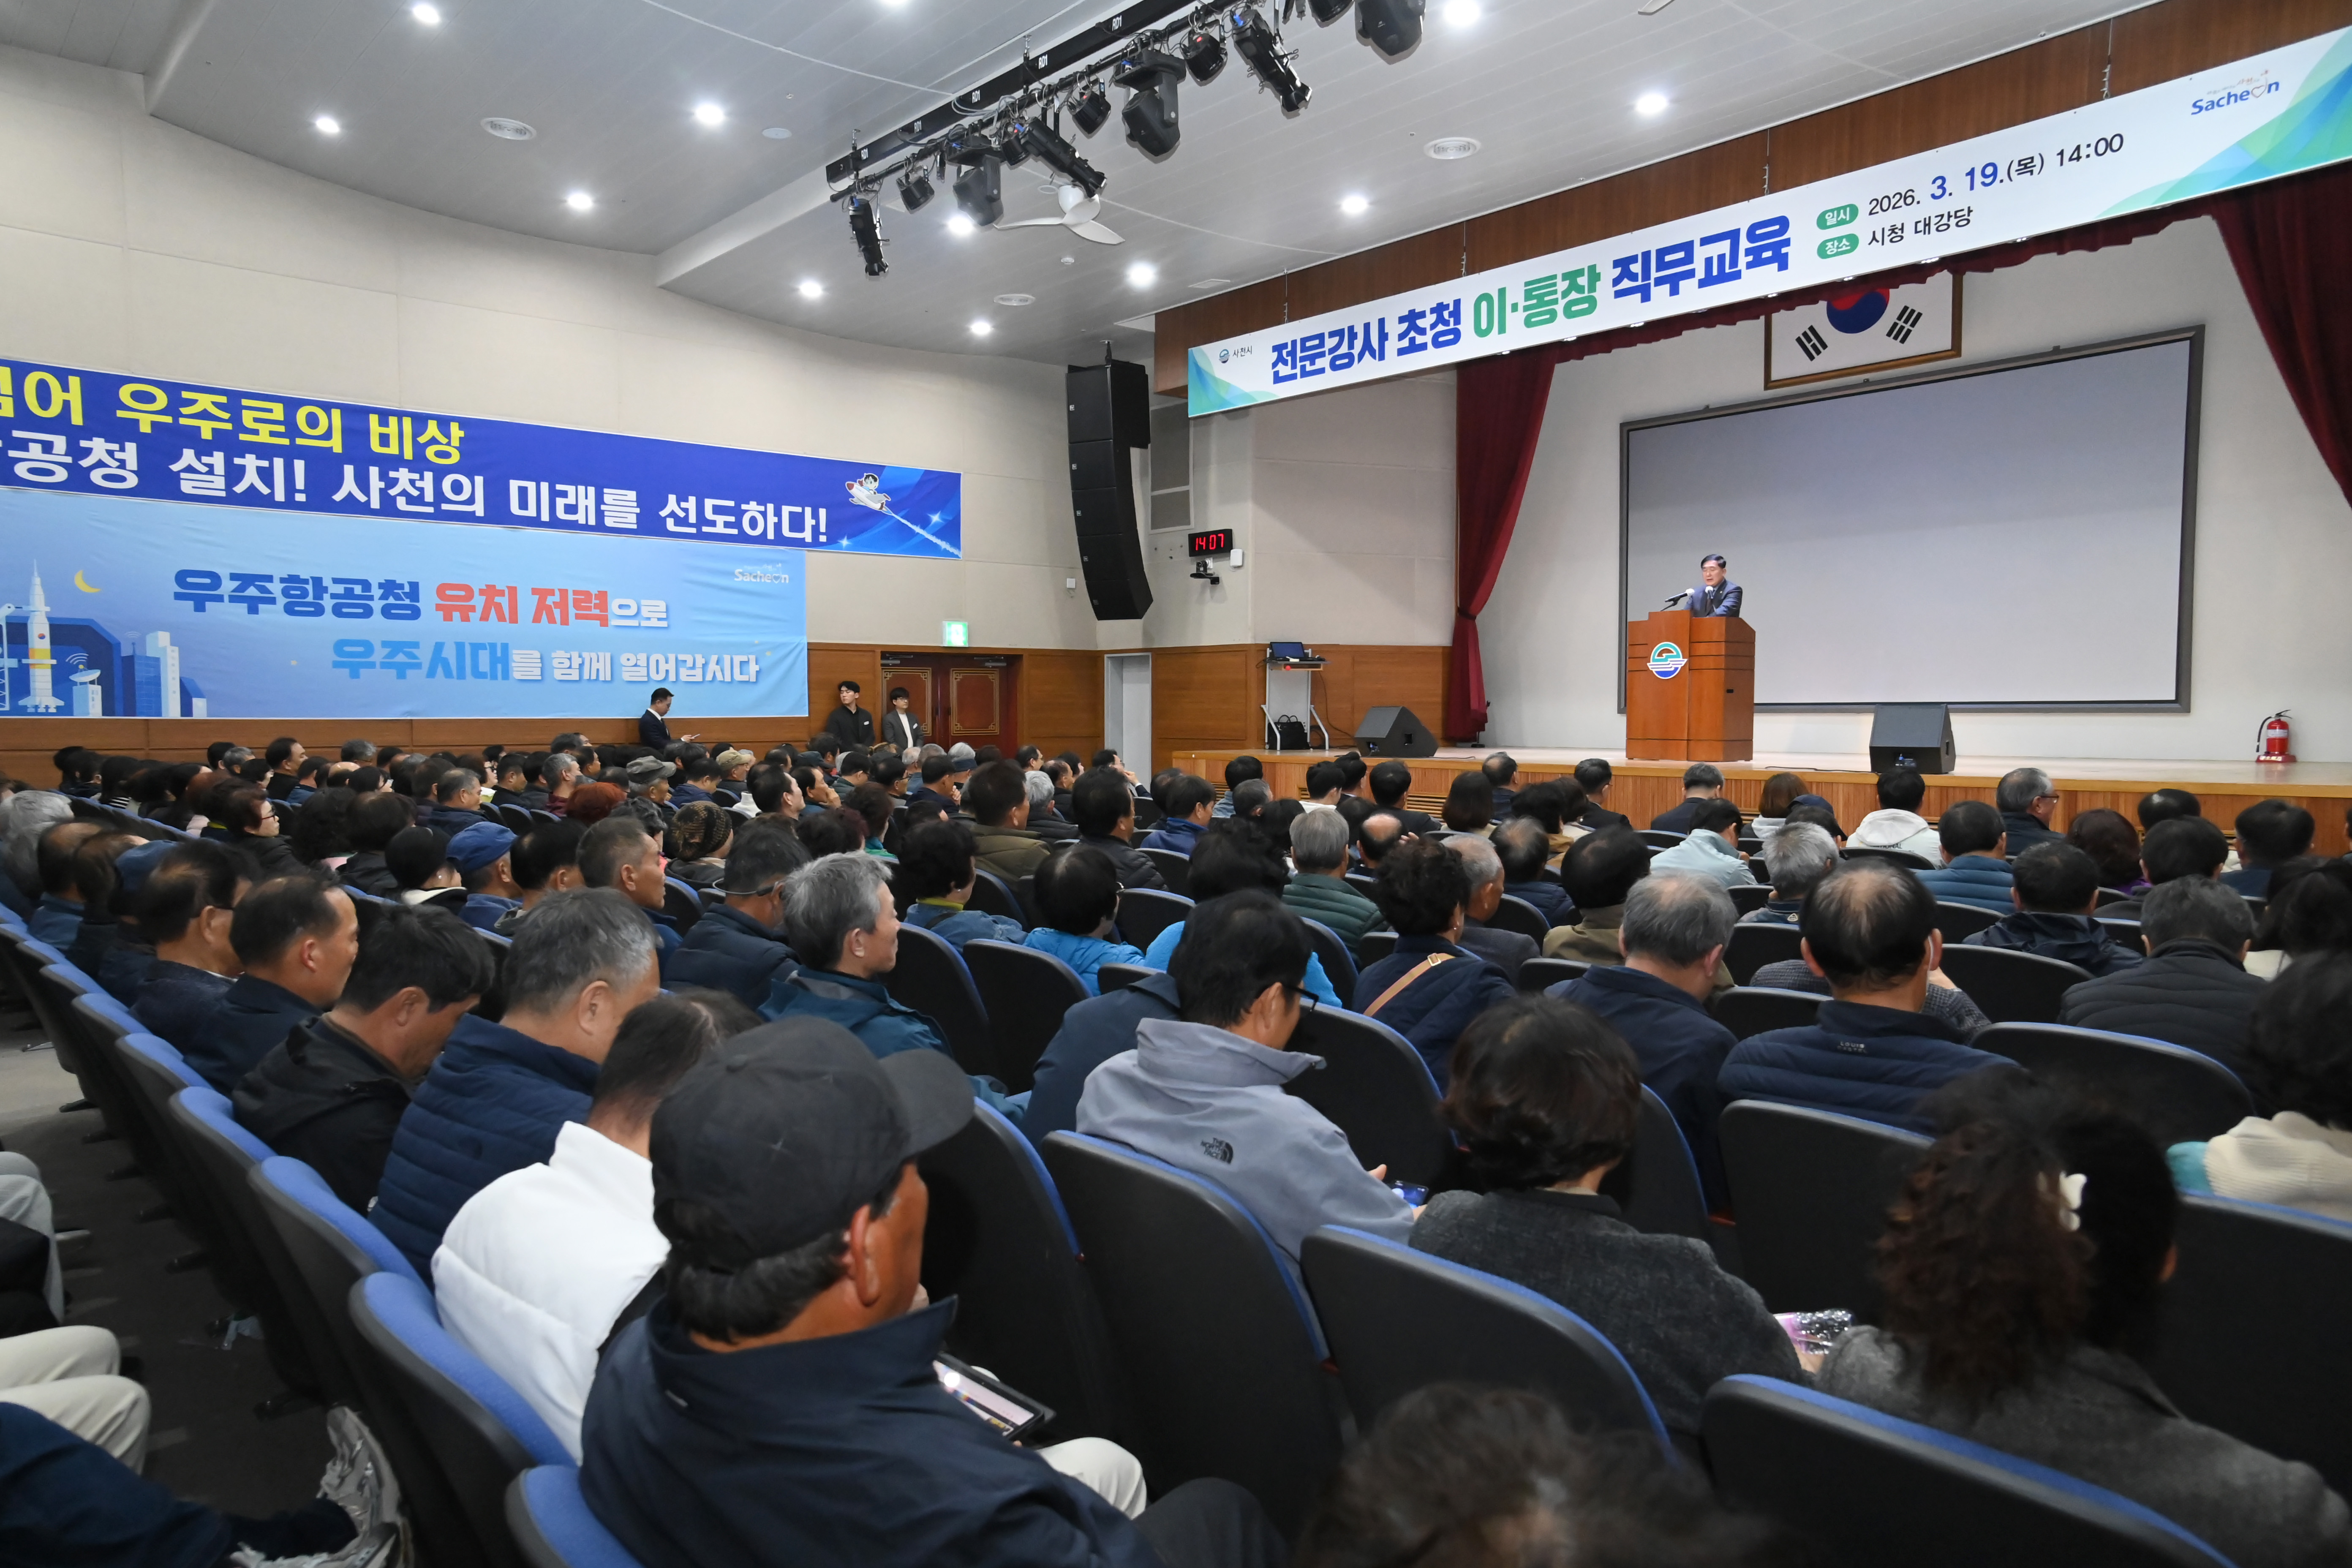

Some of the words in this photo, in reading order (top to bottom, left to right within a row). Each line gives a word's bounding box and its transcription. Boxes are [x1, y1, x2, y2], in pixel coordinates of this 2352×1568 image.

[1112, 15, 1122, 31] RD1
[1038, 54, 1048, 69] RD1
[972, 90, 980, 103] RD1
[914, 120, 922, 133] RD1
[1868, 189, 1921, 216] 2026.
[1930, 175, 1953, 200] 3.
[2056, 133, 2124, 167] 14:00
[1825, 207, 1850, 226] 일시
[1868, 223, 1905, 246] 시청
[1914, 206, 1973, 235] 대강당
[1825, 238, 1851, 255] 장소
[1271, 318, 1389, 385] 전문강사
[1396, 298, 1462, 357] 초청
[1612, 215, 1791, 304] 직무교육
[1232, 345, 1252, 358] 사천시
[0, 366, 84, 426] 어
[117, 383, 343, 453] 우주로의
[370, 414, 465, 464] 비상
[0, 430, 139, 489] 공청
[169, 448, 307, 502] 설치!
[332, 465, 485, 517] 사천의
[509, 479, 641, 529] 미래를
[659, 494, 827, 543] 선도하다!
[174, 569, 421, 621] 우주항공청
[435, 583, 518, 624] 유치
[531, 587, 668, 628] 저력으로
[332, 638, 542, 681] 우주시대를
[551, 650, 611, 681] 함께
[620, 652, 760, 682] 열어갑시다
